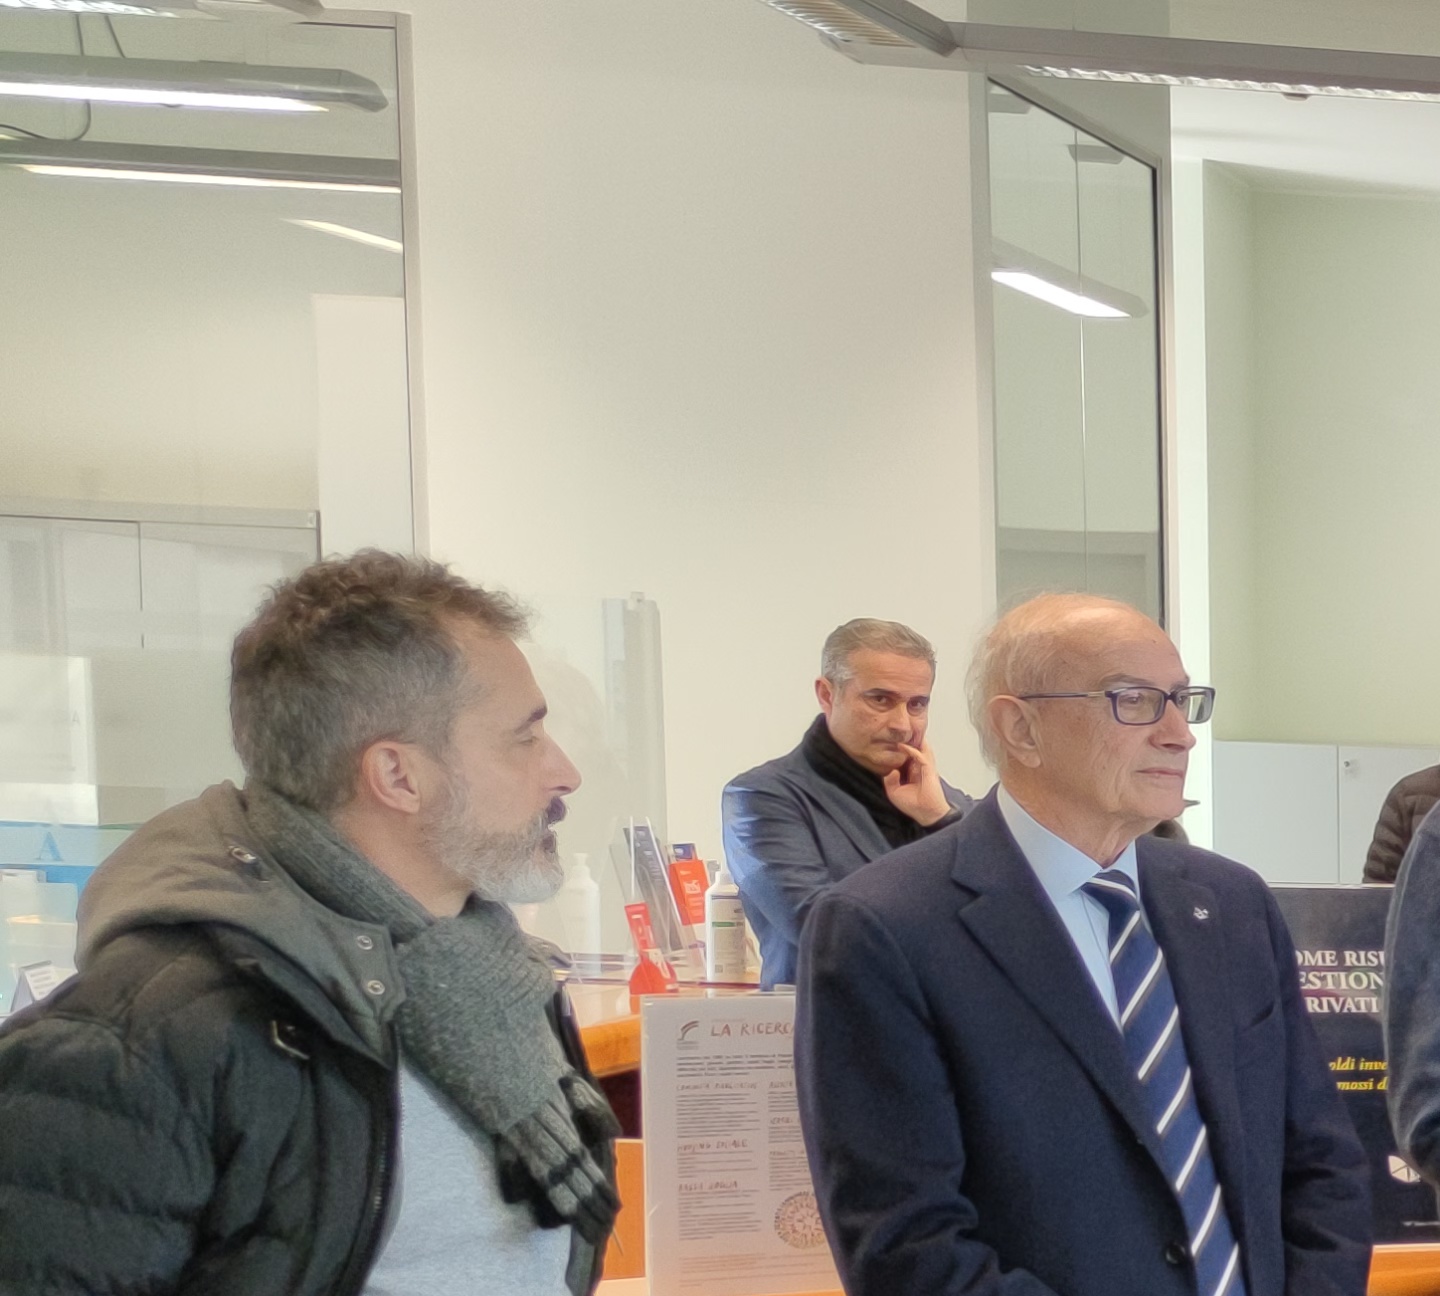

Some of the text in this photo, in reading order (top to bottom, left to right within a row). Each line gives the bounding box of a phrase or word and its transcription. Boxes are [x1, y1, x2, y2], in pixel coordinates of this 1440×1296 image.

[1305, 996, 1380, 1013] RIVATI
[710, 1022, 794, 1037] LA RICERC
